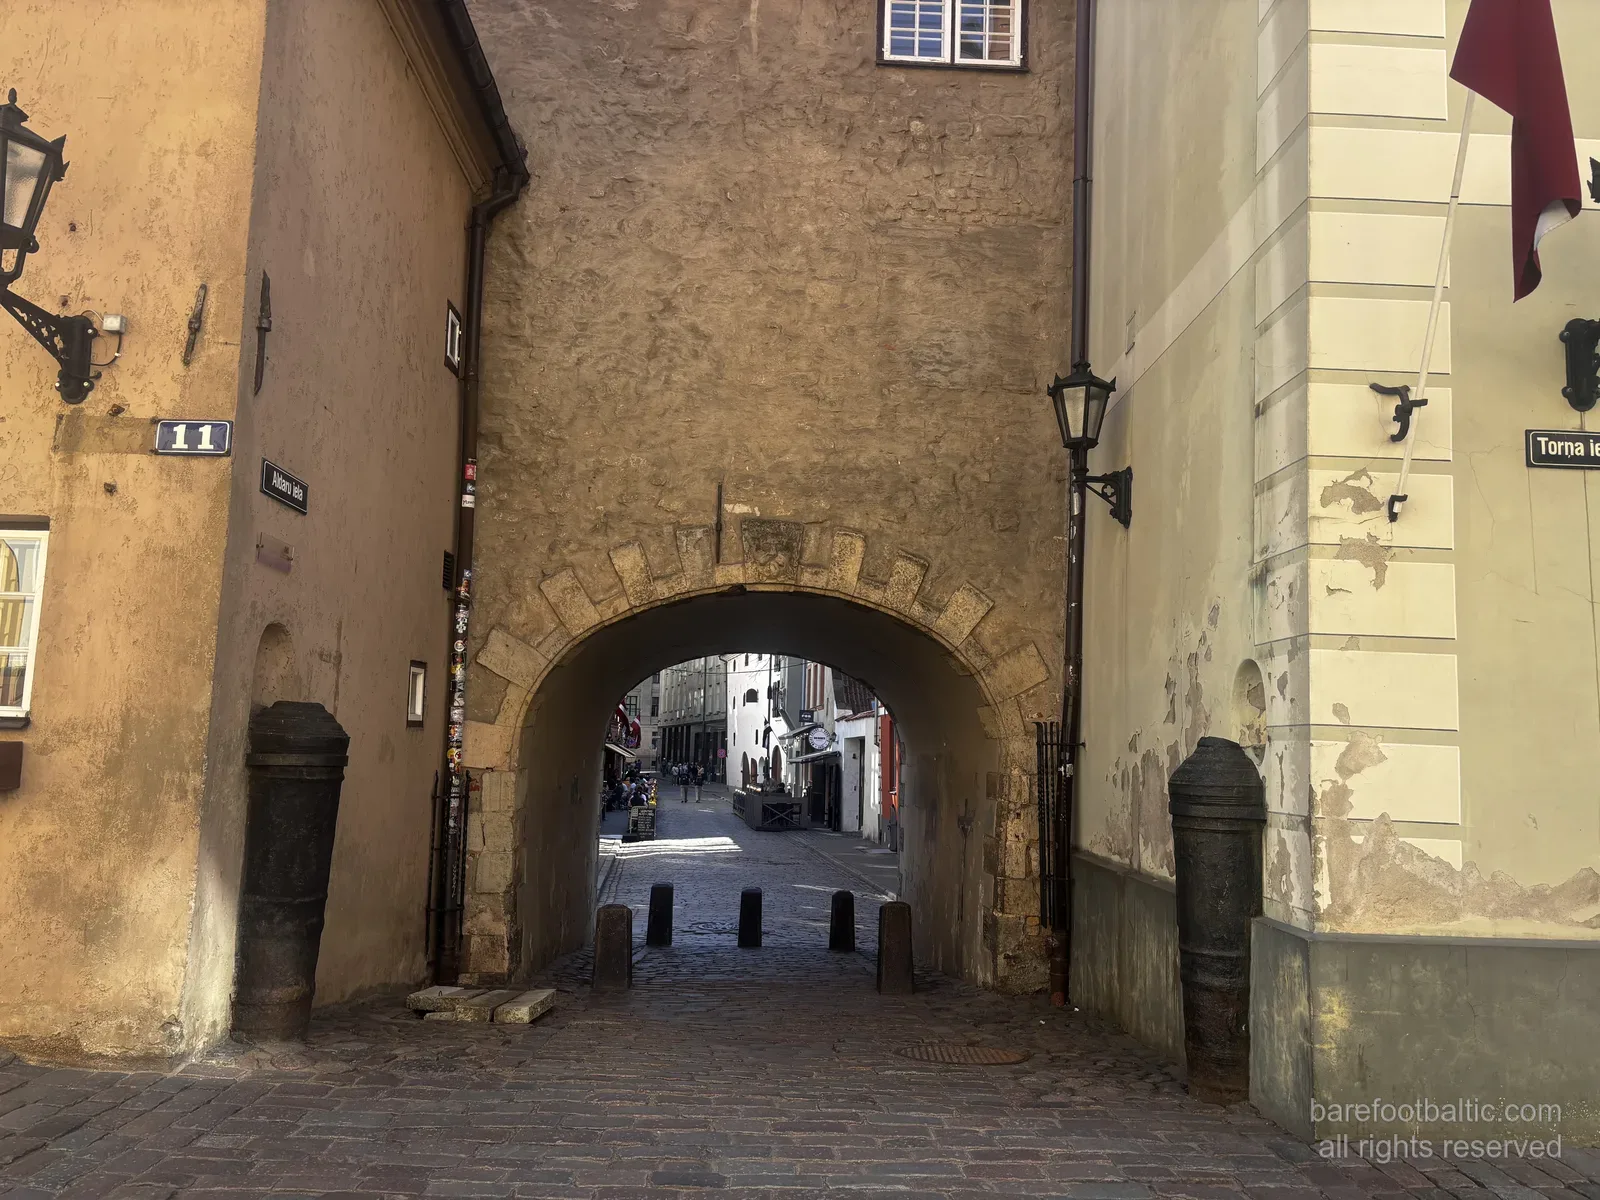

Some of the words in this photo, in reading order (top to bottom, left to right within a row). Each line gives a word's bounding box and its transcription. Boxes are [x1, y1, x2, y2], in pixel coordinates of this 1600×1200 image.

[172, 424, 214, 450] 11
[1536, 436, 1585, 458] Torņa
[272, 470, 292, 495] Aldaru
[292, 482, 303, 501] iela
